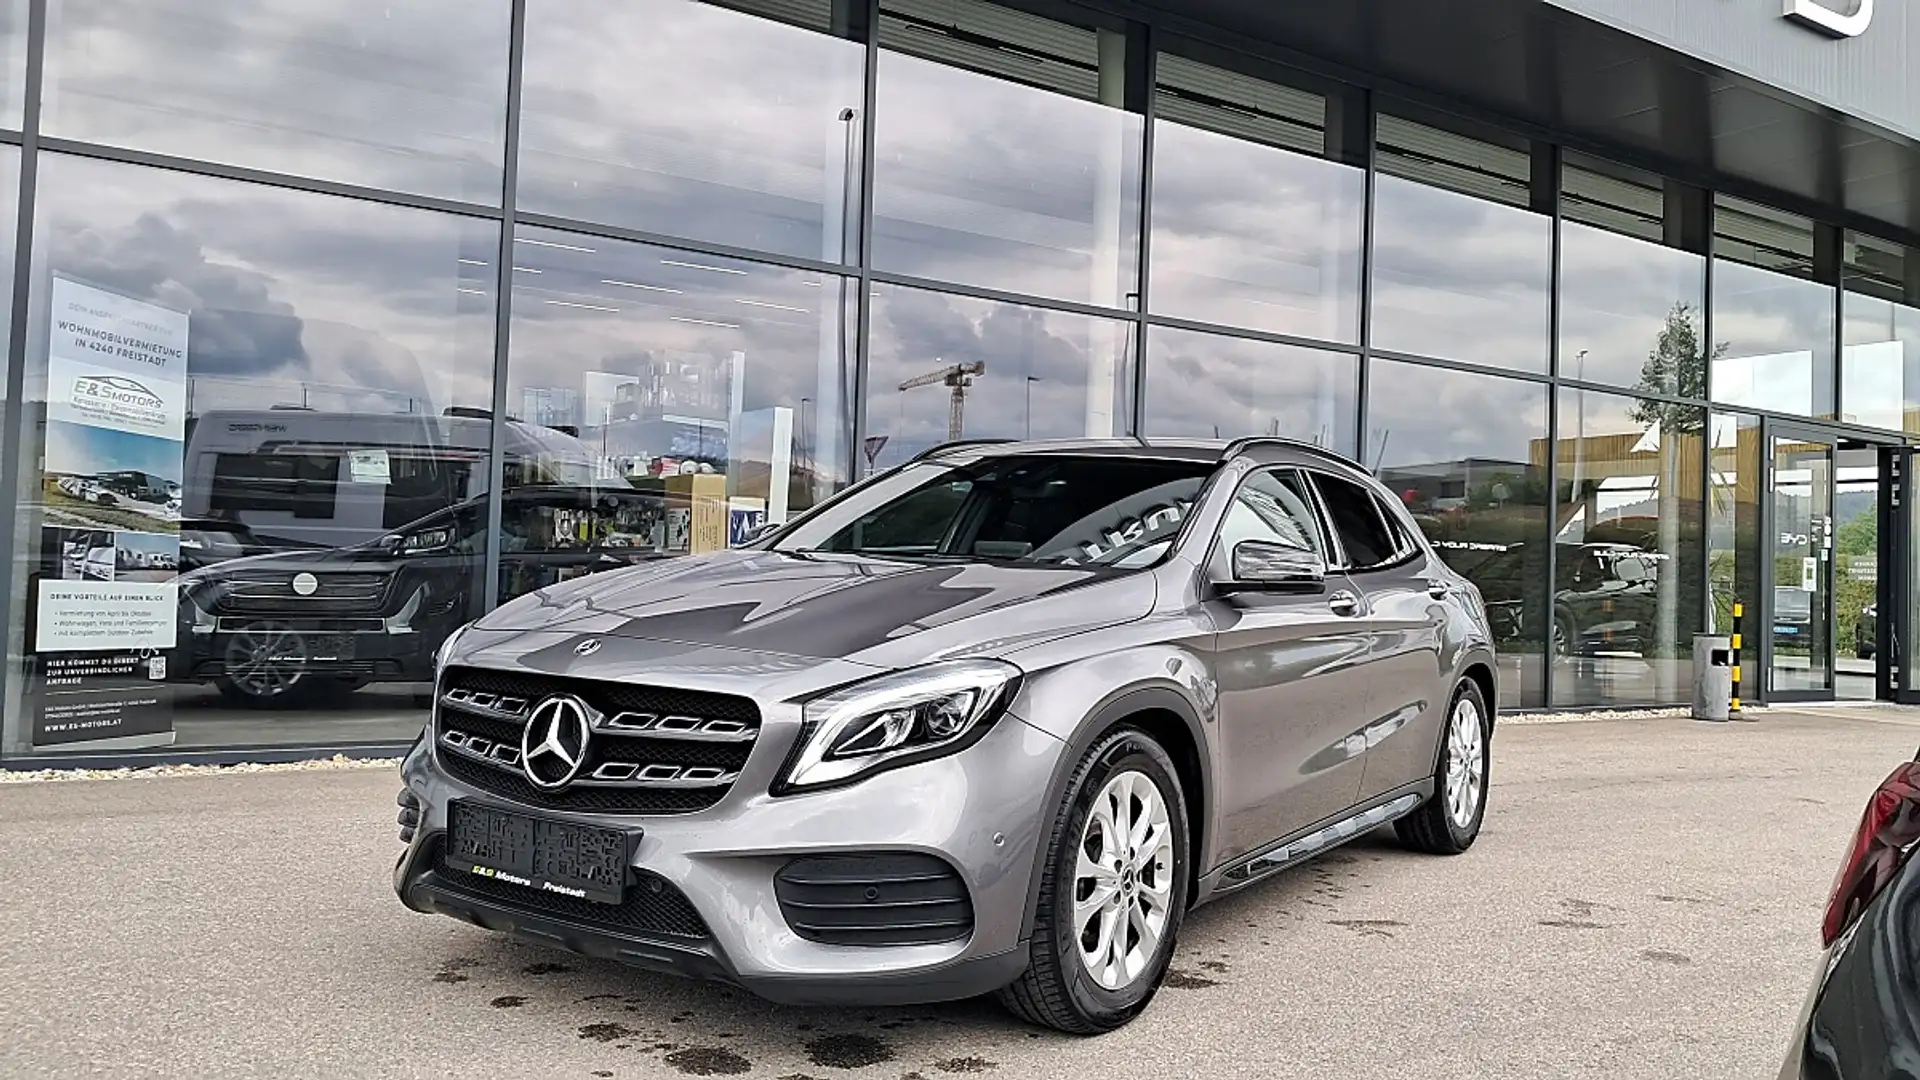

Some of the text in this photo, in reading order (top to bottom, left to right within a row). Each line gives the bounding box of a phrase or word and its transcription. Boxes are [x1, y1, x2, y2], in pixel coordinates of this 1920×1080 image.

[59, 320, 182, 358] WOHNMOBILVERMIETUNG
[75, 338, 166, 367] IN 4240 FREISTADT
[1442, 541, 1468, 549] YOUR
[74, 593, 107, 601] VORTEILE
[113, 657, 139, 665] DIREKT
[64, 666, 132, 675] UNVERBINDLICHEN
[45, 719, 121, 732] WWW.ES-MOTORS.AT
[495, 870, 531, 886] Motors
[543, 882, 586, 898] Freistadt
